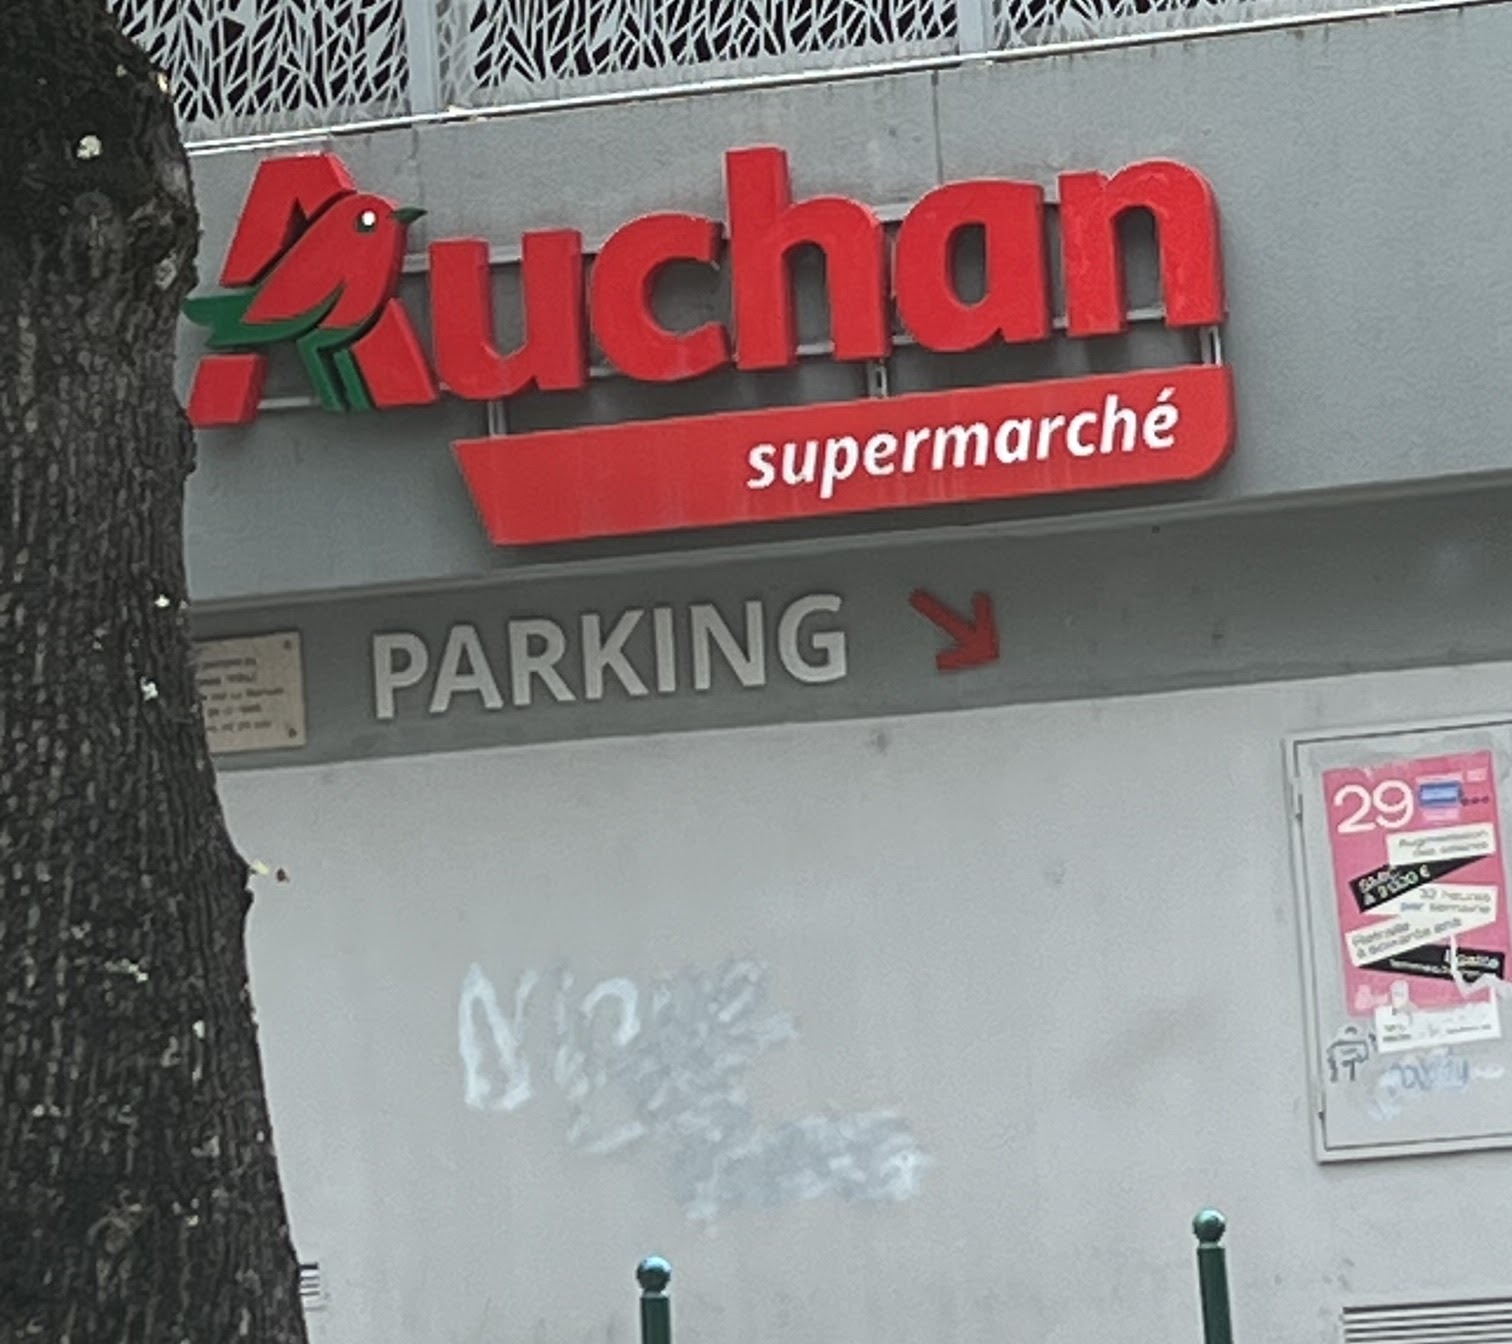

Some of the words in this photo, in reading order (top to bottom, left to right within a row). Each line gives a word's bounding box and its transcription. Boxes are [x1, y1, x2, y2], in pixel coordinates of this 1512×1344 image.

[188, 143, 1227, 427] Auchan
[747, 387, 1180, 499] supermarché
[372, 594, 847, 720] PARKING
[1334, 779, 1414, 833] 29
